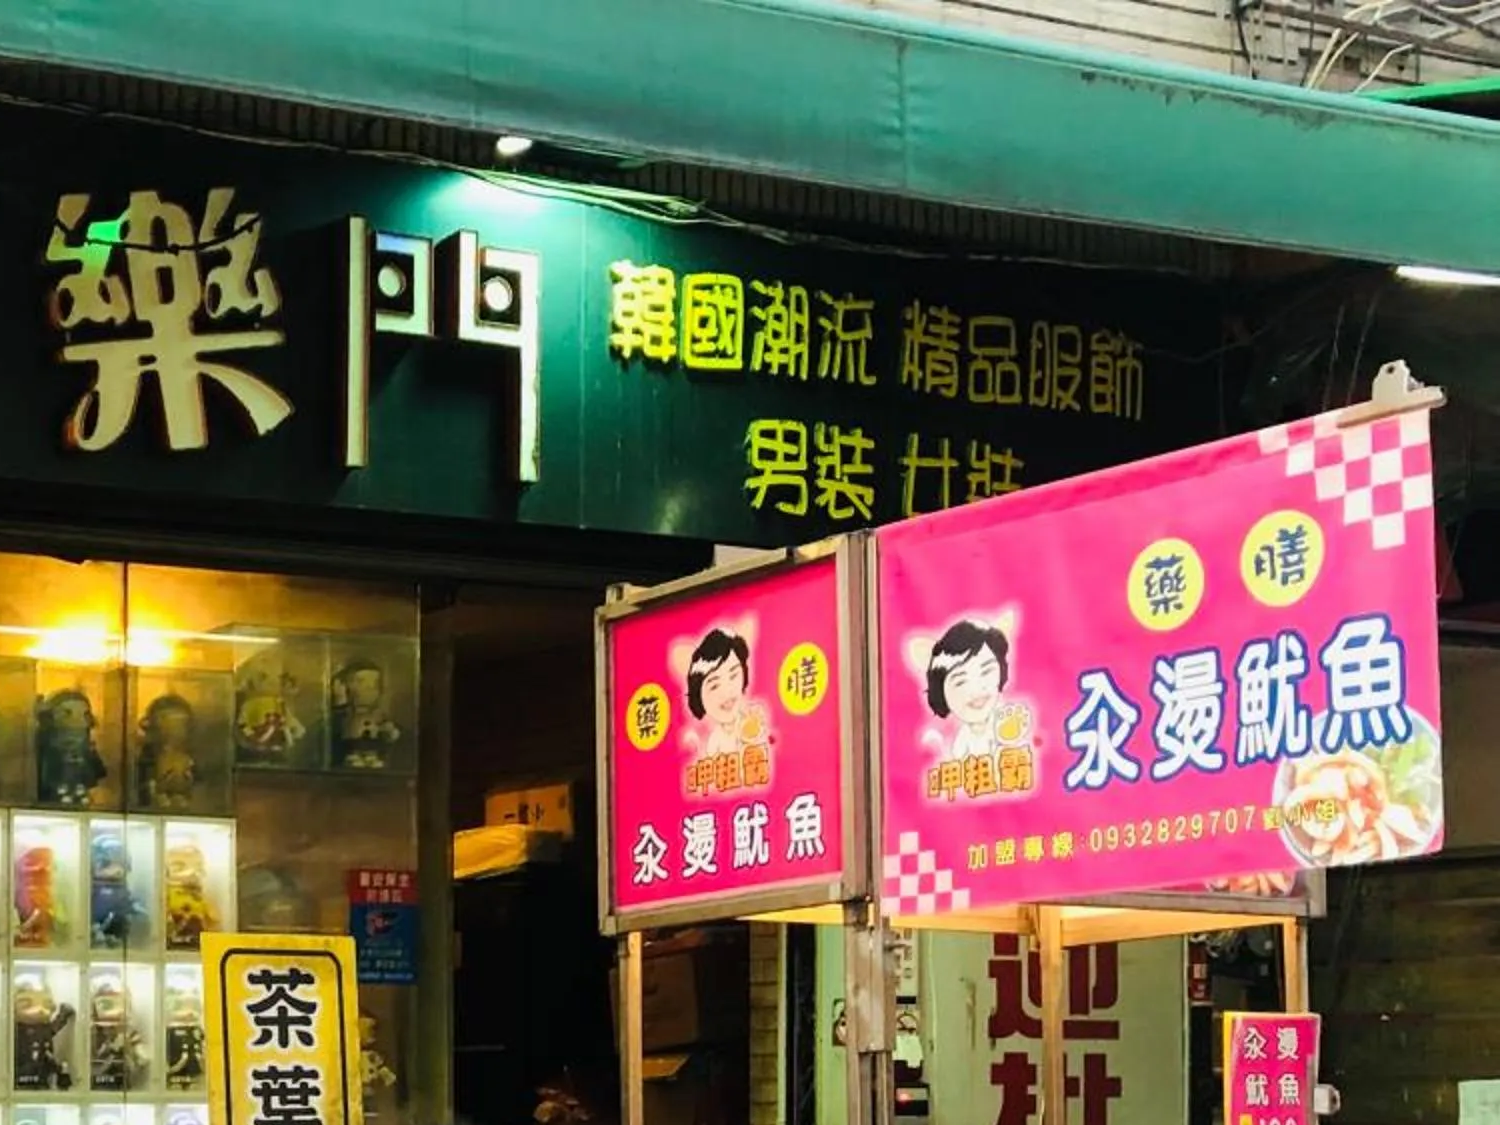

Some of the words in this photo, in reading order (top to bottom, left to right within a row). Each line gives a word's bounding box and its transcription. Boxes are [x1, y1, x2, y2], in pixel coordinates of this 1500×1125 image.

[608, 260, 876, 385] 韓國潮流
[902, 300, 1143, 421] 精品服飾
[744, 419, 875, 521] 男裝
[1143, 524, 1310, 617] 藥膳
[687, 742, 770, 796] 呷粗霸
[927, 739, 1036, 804] 呷粗霸
